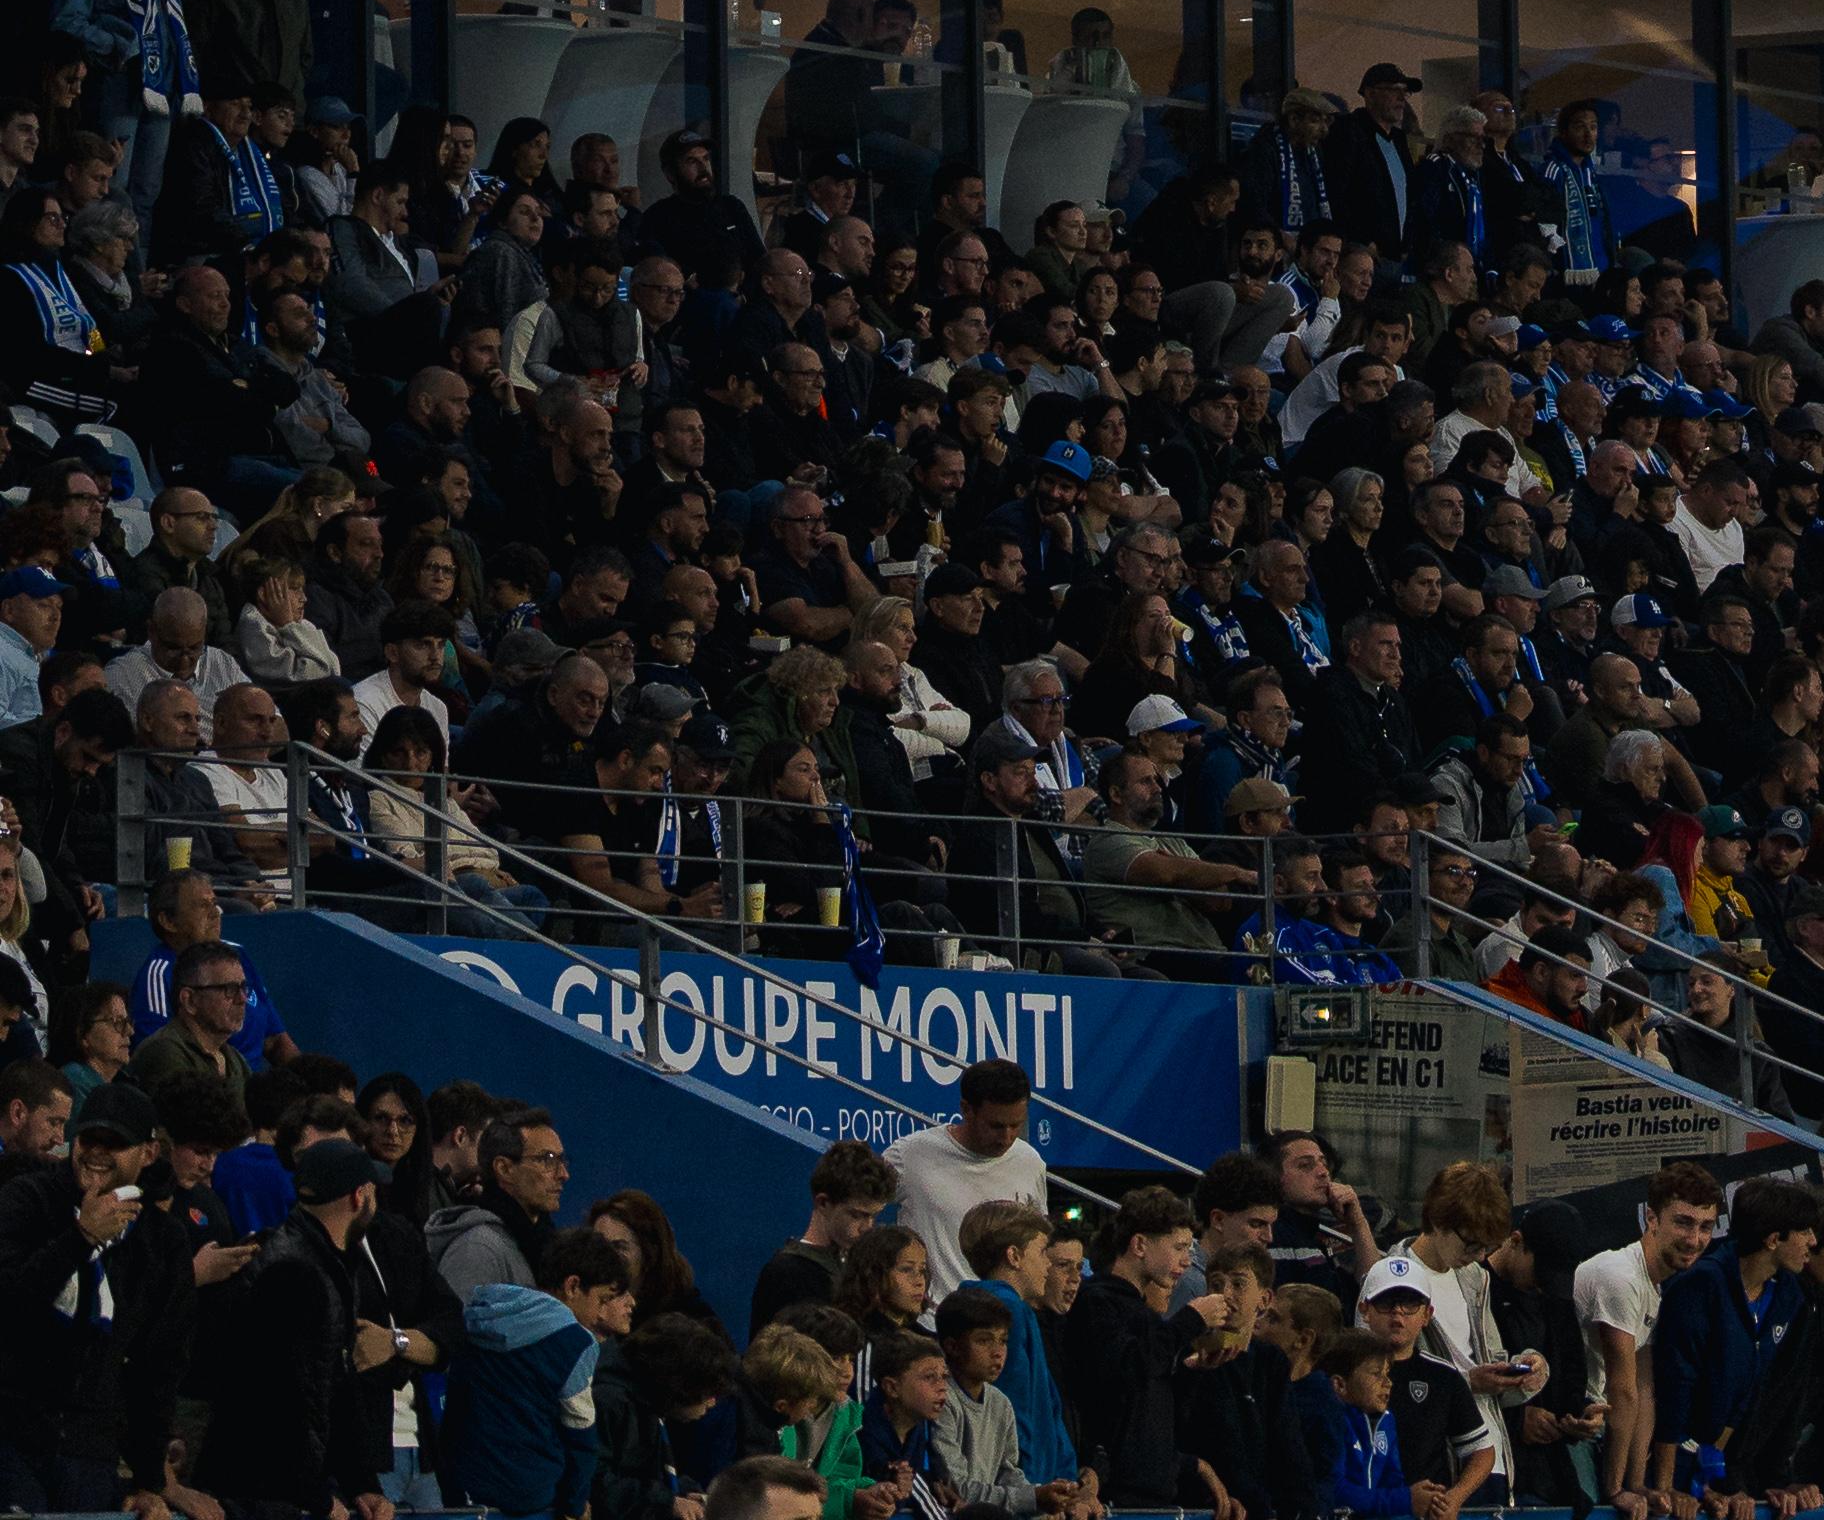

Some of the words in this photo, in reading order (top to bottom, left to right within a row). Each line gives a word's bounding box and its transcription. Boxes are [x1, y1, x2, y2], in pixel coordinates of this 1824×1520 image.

[552, 965, 836, 1080] GROUPE
[860, 985, 1075, 1090] MONTI
[1306, 1053, 1369, 1085] LACE
[1377, 1058, 1408, 1086] EN
[1415, 1059, 1444, 1089] C1
[1576, 1094, 1643, 1116] Bastia
[1551, 1122, 1622, 1142] récrire
[1626, 1116, 1720, 1136] l'histoire
